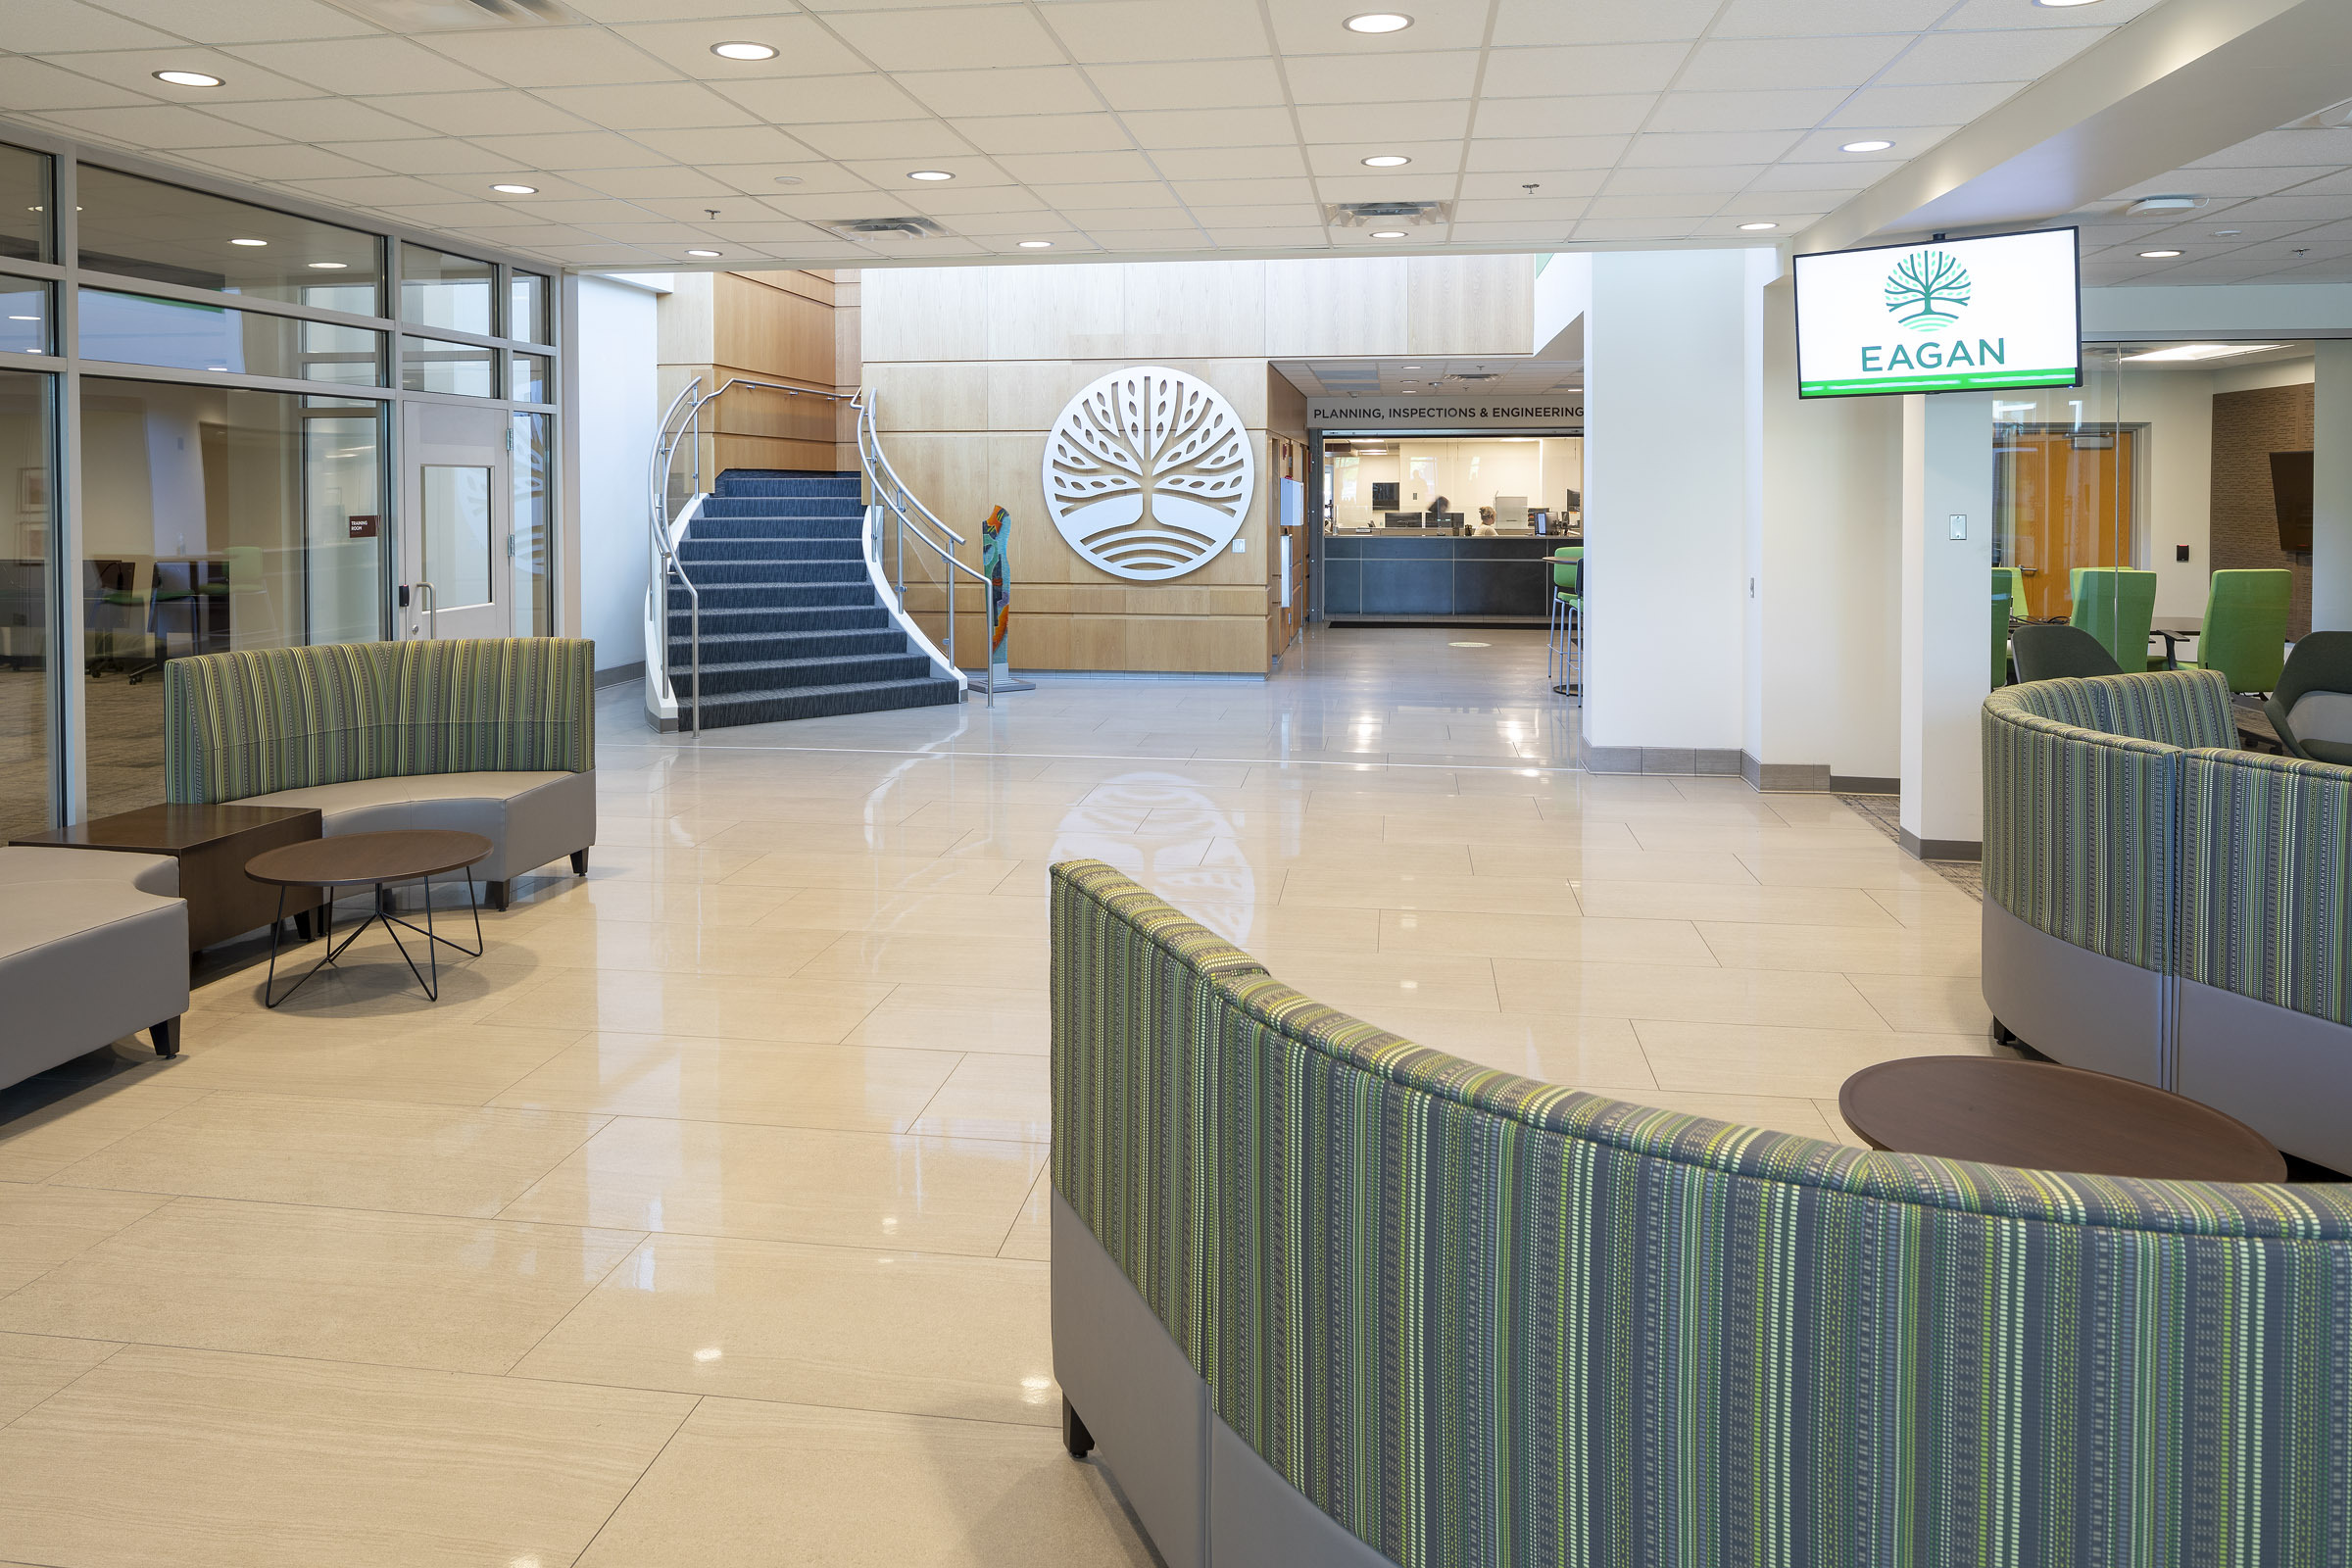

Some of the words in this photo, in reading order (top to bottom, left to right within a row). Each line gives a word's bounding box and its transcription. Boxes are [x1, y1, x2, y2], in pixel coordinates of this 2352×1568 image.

[1862, 338, 2004, 371] EAGAN
[1313, 409, 1385, 419] PLANNING,
[1389, 408, 1476, 417] INSPECTIONS
[1480, 408, 1489, 417] &
[1493, 407, 1584, 417] ENGINEERING
